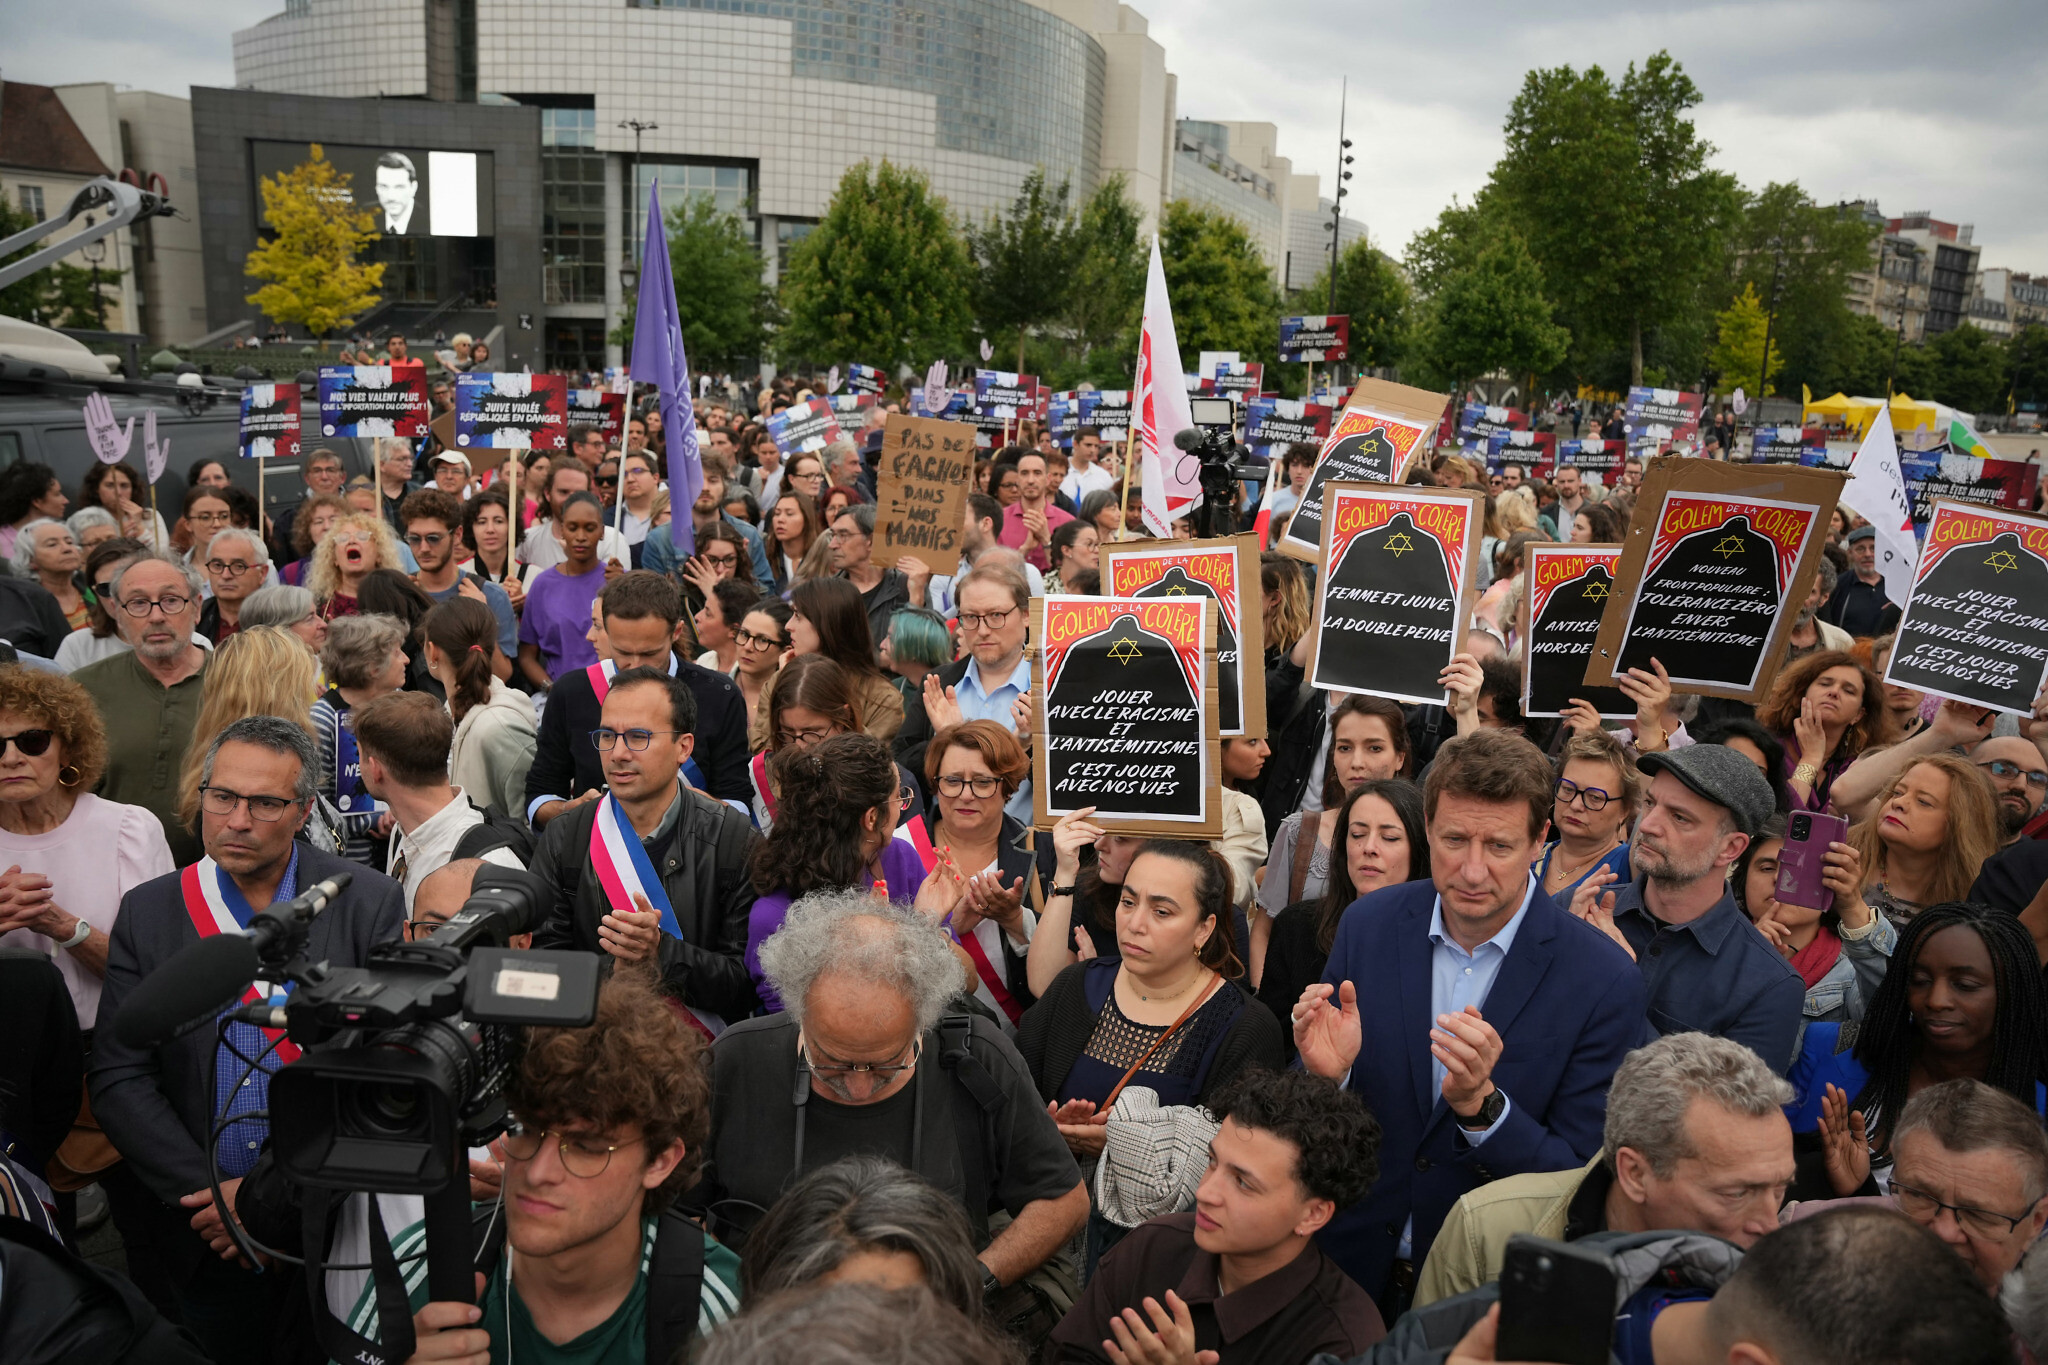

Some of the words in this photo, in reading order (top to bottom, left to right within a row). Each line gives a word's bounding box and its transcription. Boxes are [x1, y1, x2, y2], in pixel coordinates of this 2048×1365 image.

[329, 392, 346, 402] NOS
[348, 392, 367, 402] VIES
[368, 392, 397, 402] VALENT
[400, 392, 420, 402] PLUS
[978, 394, 990, 402] LES
[460, 410, 511, 422] RÉPUBLIQUE
[512, 414, 524, 422] EN
[524, 414, 562, 424] DANGER
[484, 402, 510, 413] JUIVE
[512, 402, 540, 414] VIOLÉE
[1646, 405, 1658, 413] VIES
[1658, 406, 1680, 416] VALENT
[1680, 410, 1694, 418] PLUS
[1095, 418, 1128, 426] FRANÇAIS
[1261, 420, 1270, 428] NE
[1270, 422, 1302, 434] SACRIFIEZ
[1302, 426, 1316, 435] PAS
[901, 428, 934, 450] PAS
[1249, 428, 1264, 437] LES
[1264, 430, 1302, 442] FRANÇAIS
[1302, 435, 1324, 445] JUIFS
[1338, 418, 1374, 434] GOLEM
[1388, 424, 1418, 452] COLÈRE
[1350, 454, 1382, 467] +1000%
[1326, 459, 1390, 482] D'ANTISÉMITISME
[904, 484, 944, 504] DANS
[1906, 480, 1926, 491] VOUS
[1927, 481, 1950, 494] VOUS
[1950, 483, 1966, 496] ÊTES
[1968, 488, 2007, 500] HABITUÉS
[1340, 498, 1350, 506] LE
[1390, 502, 1402, 511] DE
[1406, 503, 1418, 512] LA
[907, 505, 939, 525] NOS
[1338, 502, 1388, 533] GOLEM
[1941, 510, 1951, 518] LE
[1418, 504, 1464, 544] COLÈRE
[1664, 504, 1723, 534] GOLEM
[1726, 505, 1740, 514] DE
[1744, 506, 1758, 514] LA
[1755, 508, 1806, 548] COLÈRE
[1935, 519, 1993, 542] GOLEM
[1996, 521, 2010, 530] DE
[2014, 524, 2028, 533] LA
[1116, 560, 1162, 592] GOLEM
[1162, 558, 1173, 566] DE
[1177, 556, 1188, 564] LA
[1190, 554, 1232, 590] COLÈRE
[1538, 557, 1584, 585] GOLEM
[1585, 556, 1596, 564] DE
[1599, 556, 1610, 564] LA
[1688, 564, 1747, 576] NOUVEAU
[1654, 579, 1699, 591] FRONT
[1694, 582, 1764, 596] POPULAIRE
[1327, 587, 1384, 604] FEMME
[1380, 592, 1406, 606] ET
[1402, 594, 1453, 612] JUIVE,
[1640, 592, 1736, 612] TOLÉRANCE
[1730, 598, 1778, 616] ZÉRO
[1911, 592, 1958, 610] AVEC
[1954, 602, 1981, 615] LE
[1957, 589, 2018, 610] JOUER
[1050, 606, 1109, 642] GOLEM
[1110, 604, 1124, 614] DE
[1130, 604, 1144, 612] LA
[1144, 604, 1198, 646] COLÈRE
[1325, 616, 1344, 628] LA
[1343, 618, 1407, 638] DOUBLE
[1404, 624, 1454, 643] PEINE
[1670, 614, 1736, 628] ENVERS
[1964, 618, 1992, 631] ET
[1632, 626, 1764, 647] L'ANTISÉMITISME
[1904, 619, 2048, 661] L'ANTISÉMITISME,
[1218, 650, 1237, 664] IES
[1532, 642, 1572, 654] HORS
[1914, 644, 1963, 662] C'EST
[1959, 654, 2019, 676] JOUER
[1898, 654, 1945, 671] AVEC
[1940, 665, 1980, 680] NOS
[1977, 672, 2019, 690] VIES
[1092, 690, 1152, 705] JOUER
[1048, 704, 1095, 719] AVEC
[1093, 706, 1120, 720] LE
[1117, 706, 1199, 722] RACISME
[1109, 722, 1136, 736] ET
[1050, 736, 1199, 755] L'ANTISÉMITISME,
[1068, 762, 1117, 776] C'EST
[1114, 764, 1176, 778] JOUER
[1054, 778, 1103, 792] AVEC
[1100, 780, 1139, 794] NOS
[1140, 781, 1180, 796] VIES
